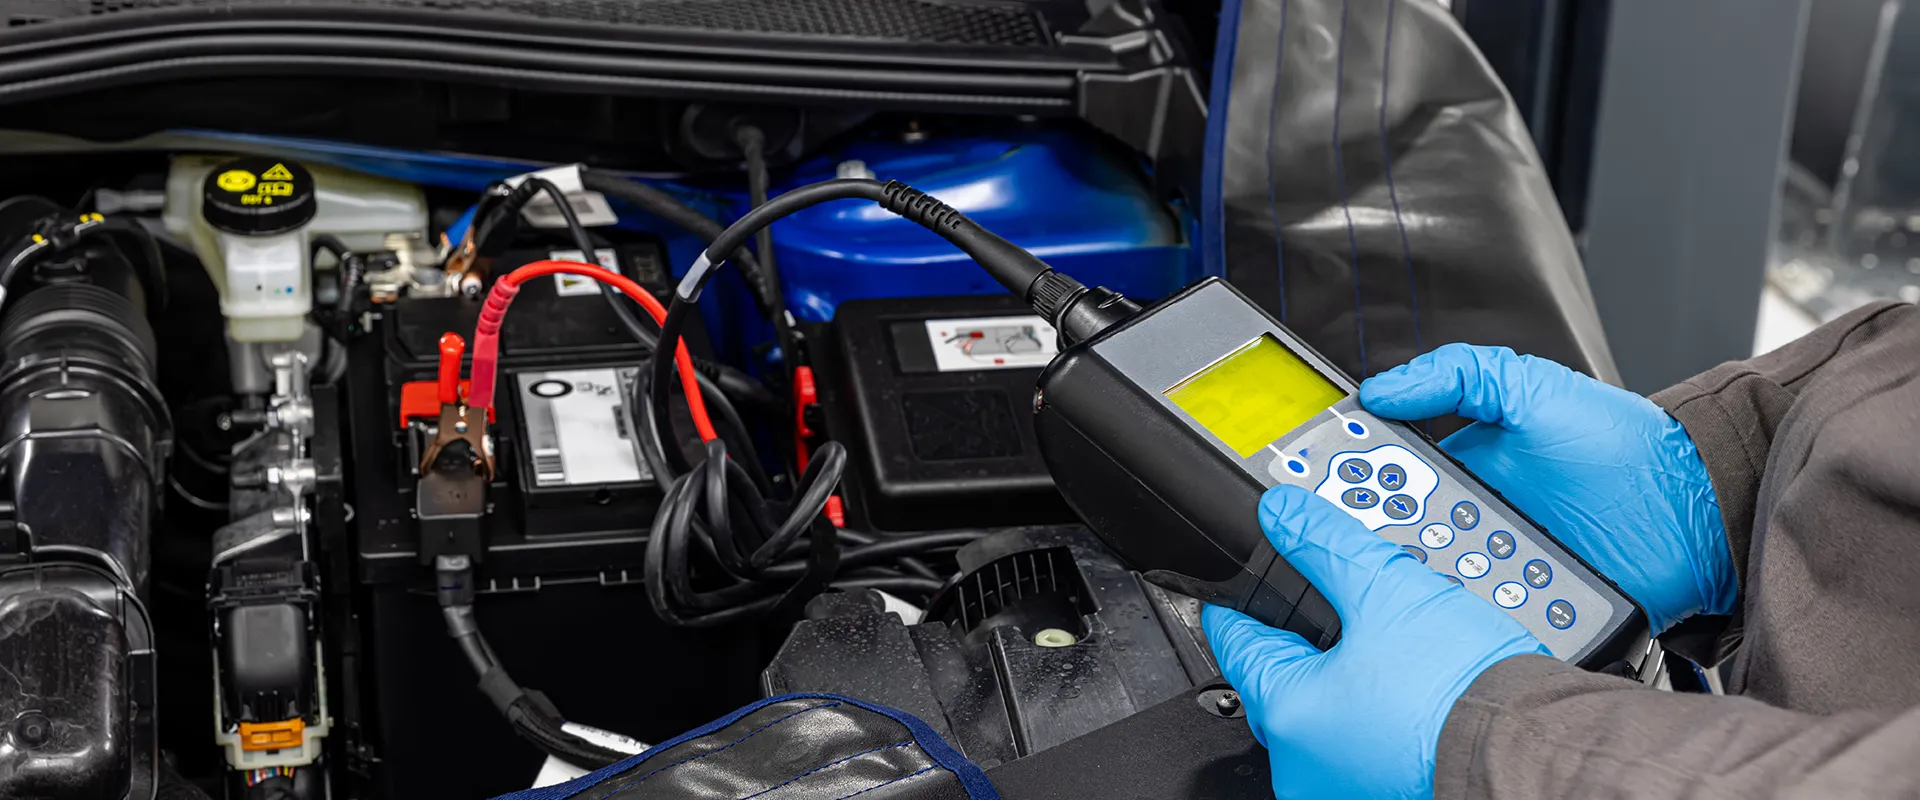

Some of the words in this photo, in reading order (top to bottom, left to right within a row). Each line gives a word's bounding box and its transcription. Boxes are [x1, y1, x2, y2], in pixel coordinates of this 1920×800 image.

[1457, 507, 1468, 516] 3
[1428, 528, 1439, 537] 2
[1493, 536, 1503, 545] 6
[1464, 557, 1475, 566] 5
[1529, 565, 1540, 574] 9
[1533, 572, 1548, 585] wxyz
[1501, 587, 1512, 595] 8
[1551, 606, 1563, 615] 0
